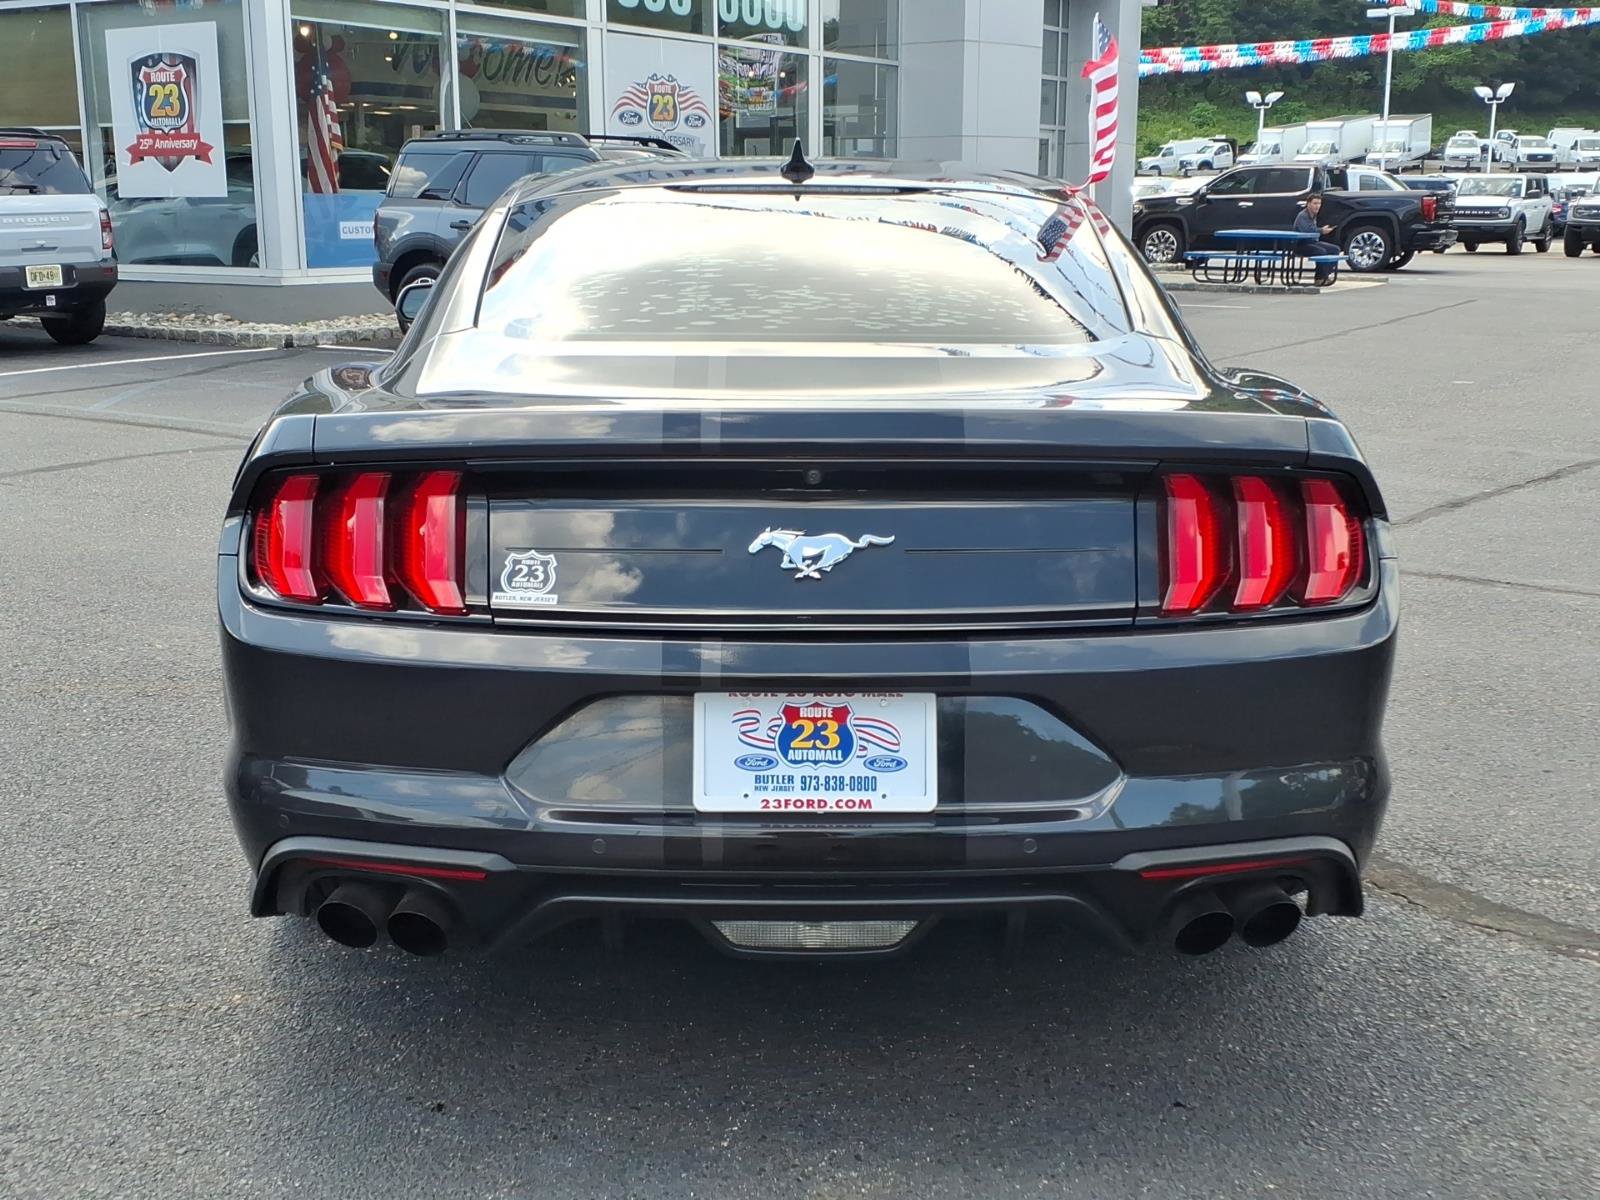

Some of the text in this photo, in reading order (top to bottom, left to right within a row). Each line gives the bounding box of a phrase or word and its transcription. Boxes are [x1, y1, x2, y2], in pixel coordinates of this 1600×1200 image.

[150, 71, 176, 82] ROUTE
[148, 83, 181, 117] 23
[652, 94, 675, 121] 23
[150, 117, 181, 127] AUTOMALL
[622, 112, 640, 126] Ford
[687, 115, 703, 127] Ford
[155, 137, 198, 150] Anniversary
[512, 564, 545, 583] 23
[799, 706, 834, 718] ROUTE
[790, 719, 841, 749] 23
[787, 749, 844, 762] AUTOMALL
[744, 756, 769, 768] Ford
[872, 757, 897, 769] Ford
[754, 774, 795, 785] BUTLER
[760, 798, 873, 809] 23FORD.COM
